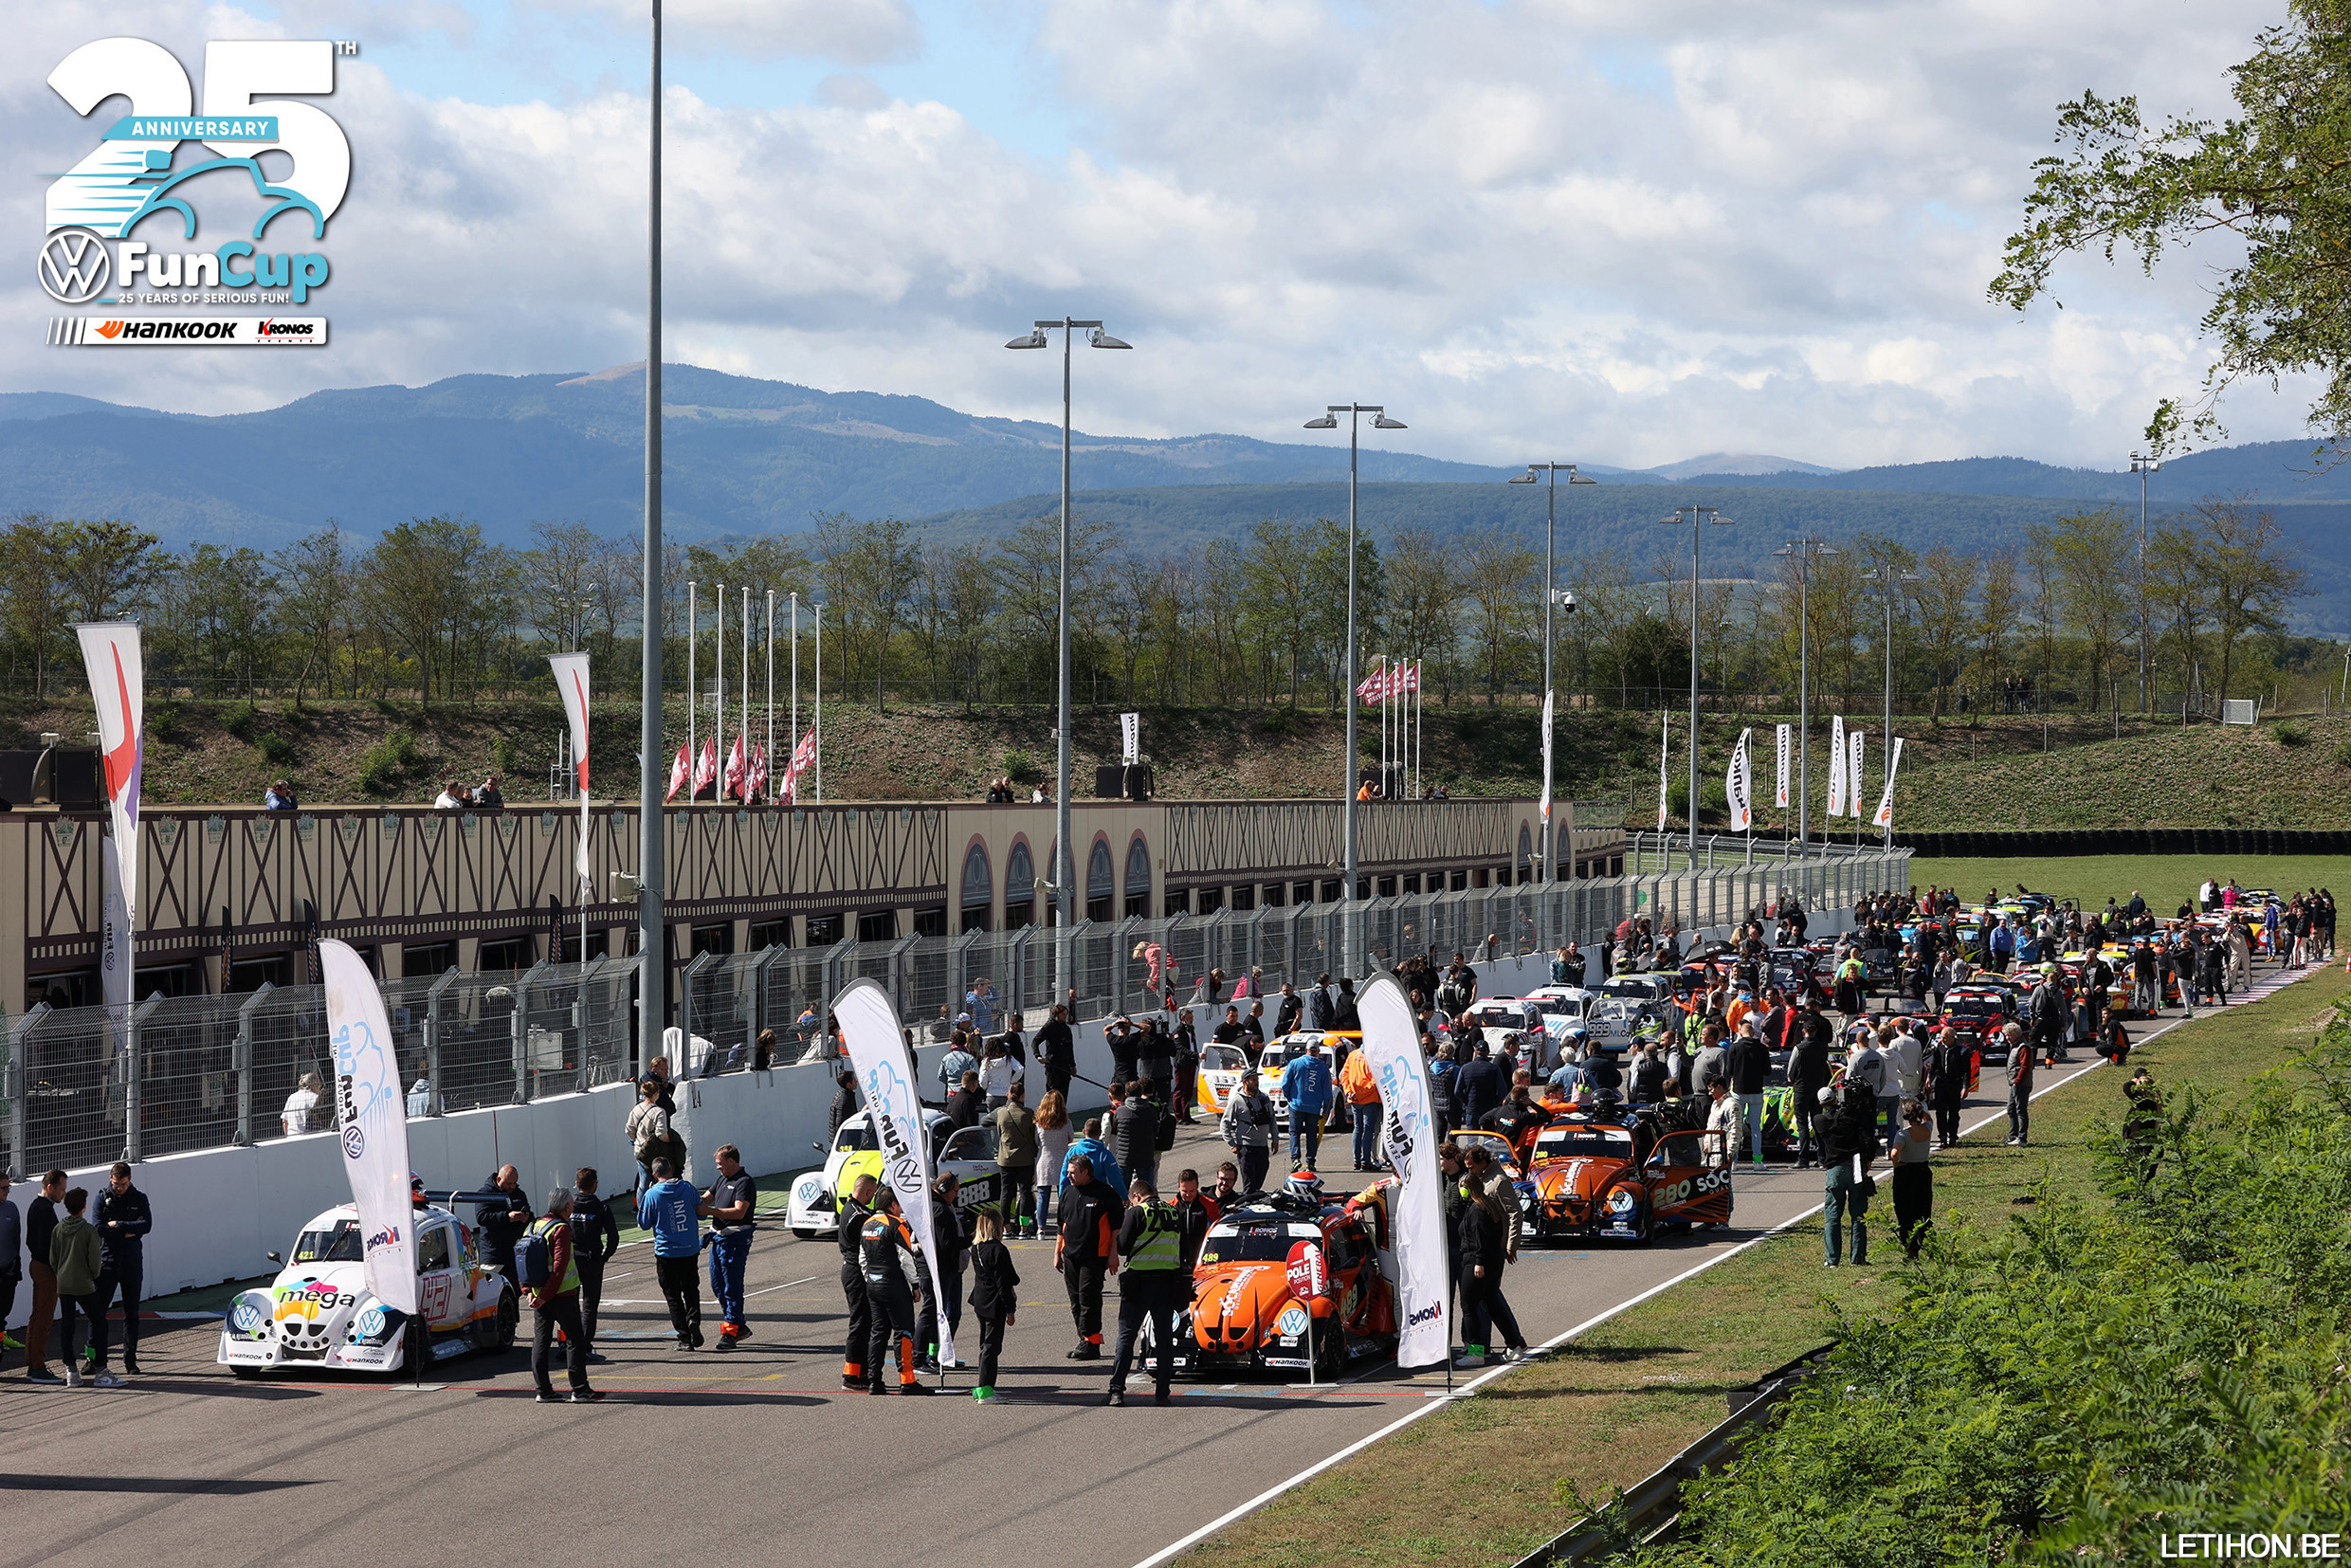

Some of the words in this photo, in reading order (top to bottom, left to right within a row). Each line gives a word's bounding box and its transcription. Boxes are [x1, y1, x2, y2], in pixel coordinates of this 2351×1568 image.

[1589, 1023, 1611, 1037] 999
[957, 1180, 991, 1208] 888
[1653, 1178, 1691, 1209] 280
[673, 1200, 688, 1232] FUN!
[298, 1251, 314, 1260] 421
[1202, 1252, 1219, 1263] 489
[1286, 1263, 1310, 1281] POLE
[1294, 1275, 1311, 1285] POSITION
[279, 1287, 355, 1310] mega
